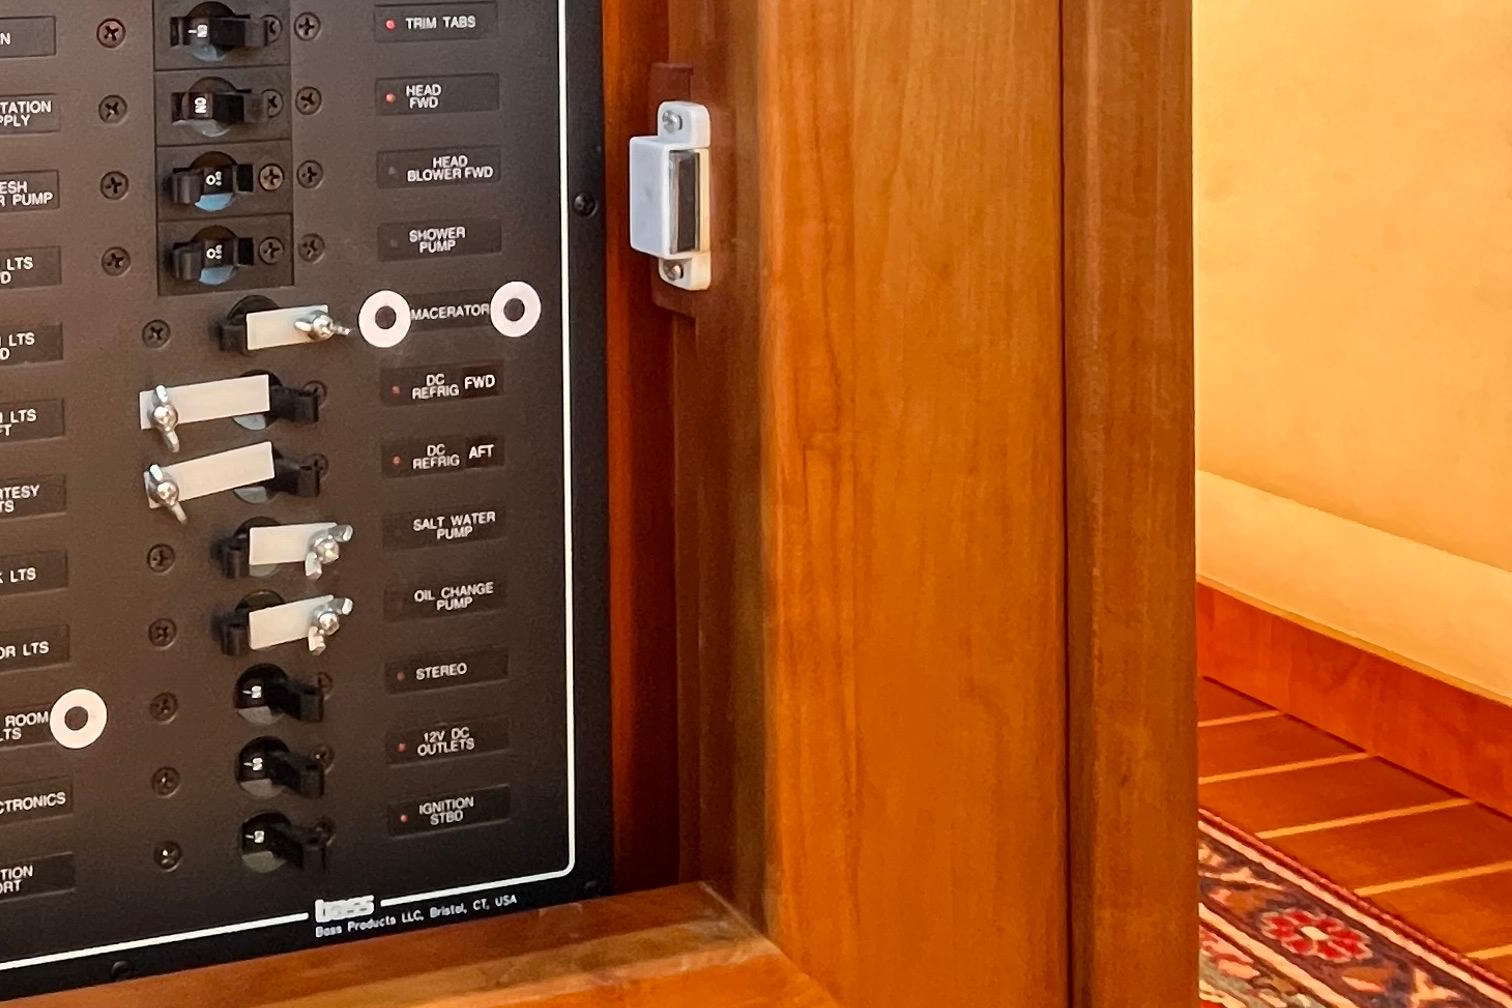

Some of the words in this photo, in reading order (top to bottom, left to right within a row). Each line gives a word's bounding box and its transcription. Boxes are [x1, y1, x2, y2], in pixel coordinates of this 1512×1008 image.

[405, 17, 437, 30] TRIM
[443, 15, 476, 29] TABS
[406, 84, 442, 97] HEAD
[194, 96, 207, 114] ON
[409, 96, 438, 109] FWD
[432, 155, 468, 169] HEAD
[407, 168, 462, 182] BLOWER
[464, 166, 493, 179] FWD
[13, 192, 53, 206] PUMP
[409, 226, 466, 243] SHOWER
[419, 239, 456, 253] PUMP
[7, 256, 34, 271] LTS
[410, 303, 490, 321] MACERATOR
[9, 332, 35, 347] LTS
[412, 384, 459, 400] REFRIG
[464, 374, 496, 390] FWD
[426, 373, 445, 387] DC
[10, 409, 37, 424] LTS
[413, 454, 460, 470] REFRIG
[469, 444, 494, 460] AFT
[427, 444, 446, 457] DC
[413, 516, 445, 532] SALT
[450, 510, 496, 527] WATER
[436, 525, 473, 541] PUMP
[10, 567, 37, 583] LTS
[414, 589, 435, 603] OIL
[441, 581, 494, 599] CHANGE
[436, 596, 473, 611] PUMP
[23, 641, 50, 657] LTS
[415, 662, 468, 681] STEREO
[5, 711, 49, 728] ROOM
[423, 730, 446, 743] 12V
[451, 726, 470, 740] DC
[417, 737, 475, 757] OUTLETS
[419, 796, 474, 815] IGNITION
[430, 810, 463, 826] STBD
[315, 925, 343, 938] Bass
[347, 915, 397, 933] Products
[494, 894, 518, 907] USA
